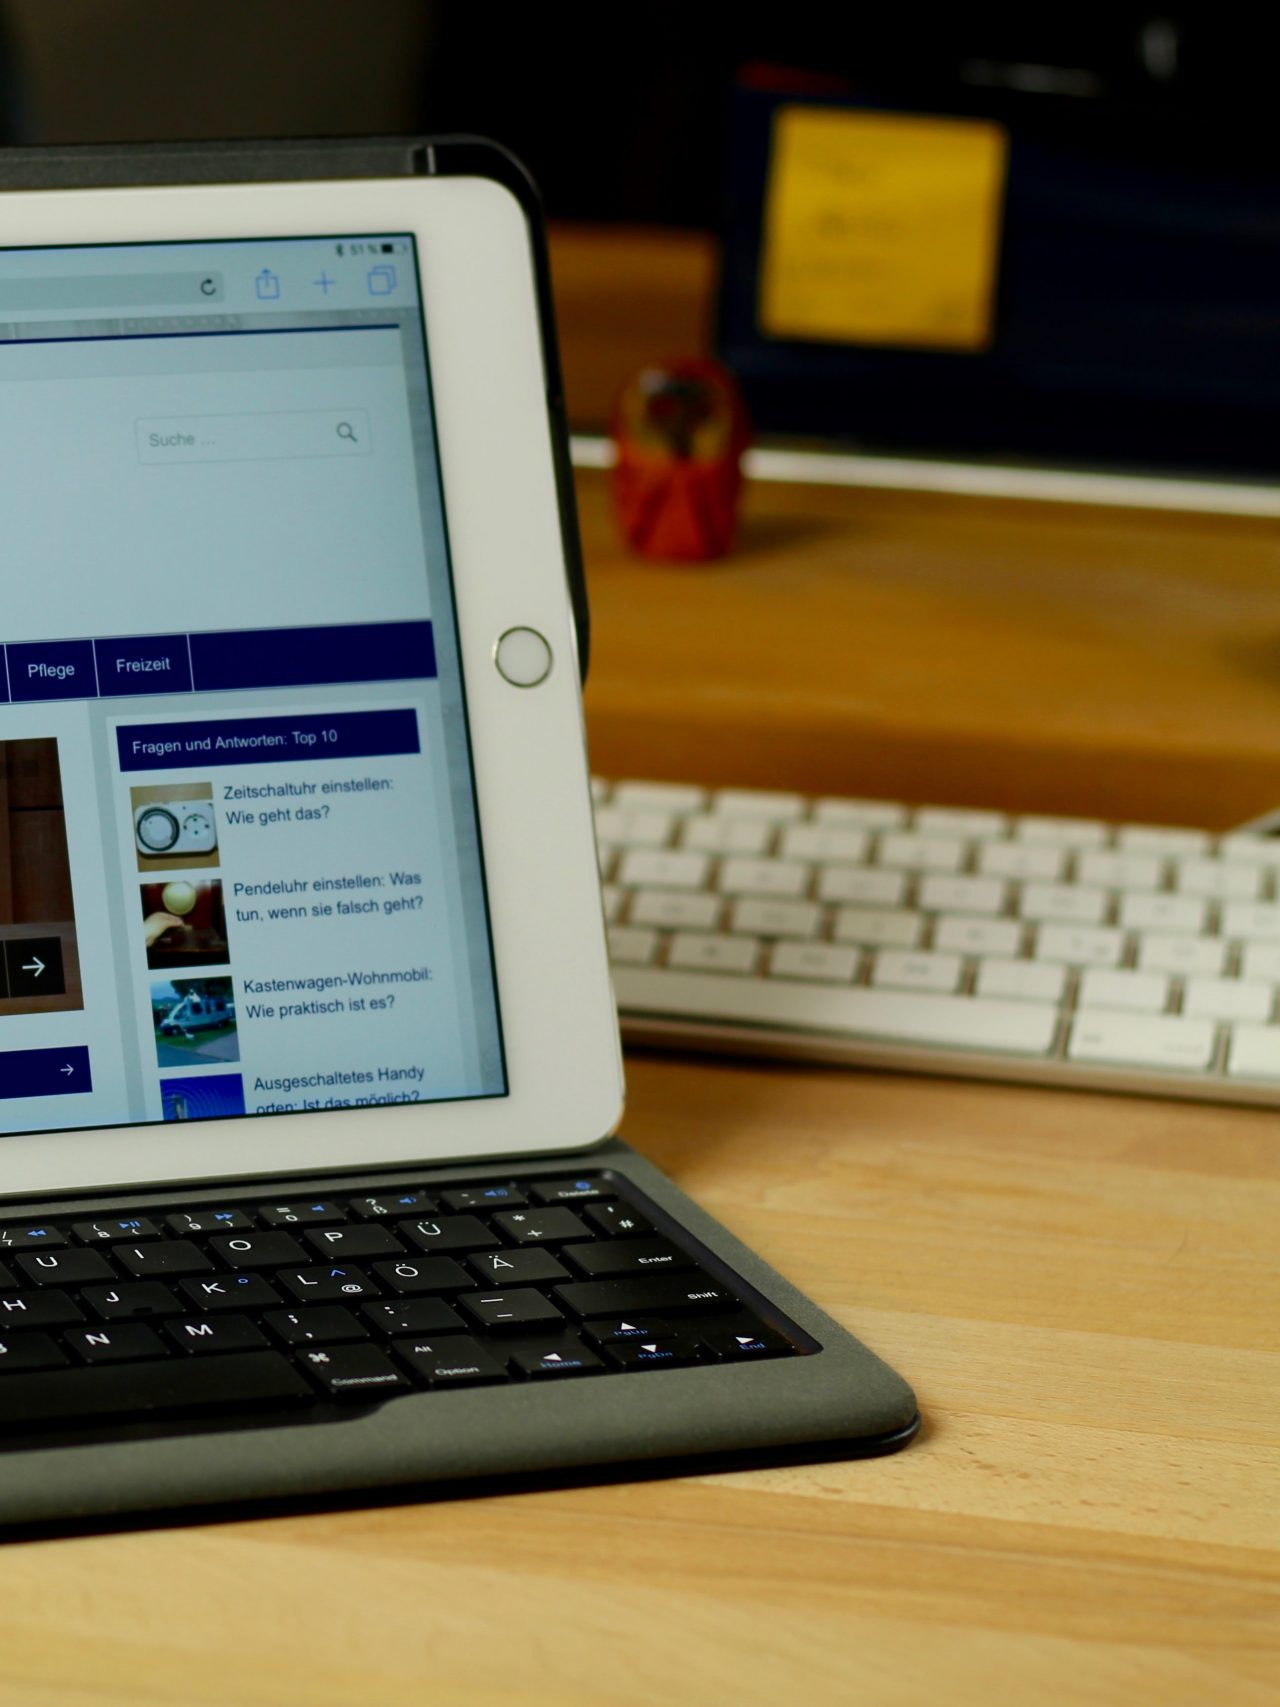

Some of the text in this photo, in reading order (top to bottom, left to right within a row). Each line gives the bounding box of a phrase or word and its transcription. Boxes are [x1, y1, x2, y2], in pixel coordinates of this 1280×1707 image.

[149, 433, 195, 447] Suche
[28, 662, 75, 680] Pflege
[116, 657, 170, 674] Freizeit
[133, 730, 337, 756] Fragen und Antworten: Top 10
[224, 777, 393, 800] Zeitschaltuhr einstellen:
[226, 805, 330, 826] Wie geht das?
[234, 871, 422, 896] Pendeluhr einstellen: Was
[236, 896, 424, 922] tun, wenn sie falsch geht?
[244, 967, 432, 994] Kastenwagen-Wohnmobil:
[246, 995, 395, 1020] Wie praktisch ist es?
[254, 1066, 425, 1092] Ausgeschaltetes Handy
[256, 1102, 297, 1114] orten:
[303, 1099, 323, 1111] Ist
[324, 1097, 351, 1108] das
[417, 1222, 441, 1236] Ü
[324, 1232, 343, 1242] P
[228, 1240, 252, 1251] O
[36, 1256, 58, 1268] U
[488, 1255, 515, 1269] Ä
[638, 1255, 673, 1264] Enter
[395, 1263, 419, 1278] Ö
[297, 1274, 318, 1286] L
[201, 1282, 226, 1294] K
[341, 1284, 363, 1294] @
[106, 1291, 120, 1302] J
[687, 1291, 719, 1300] Shift
[2, 1299, 27, 1311] H
[184, 1324, 214, 1336] M
[85, 1332, 111, 1345] N
[739, 1342, 766, 1351] End
[435, 1366, 480, 1376] Option
[330, 1373, 399, 1387] Command
